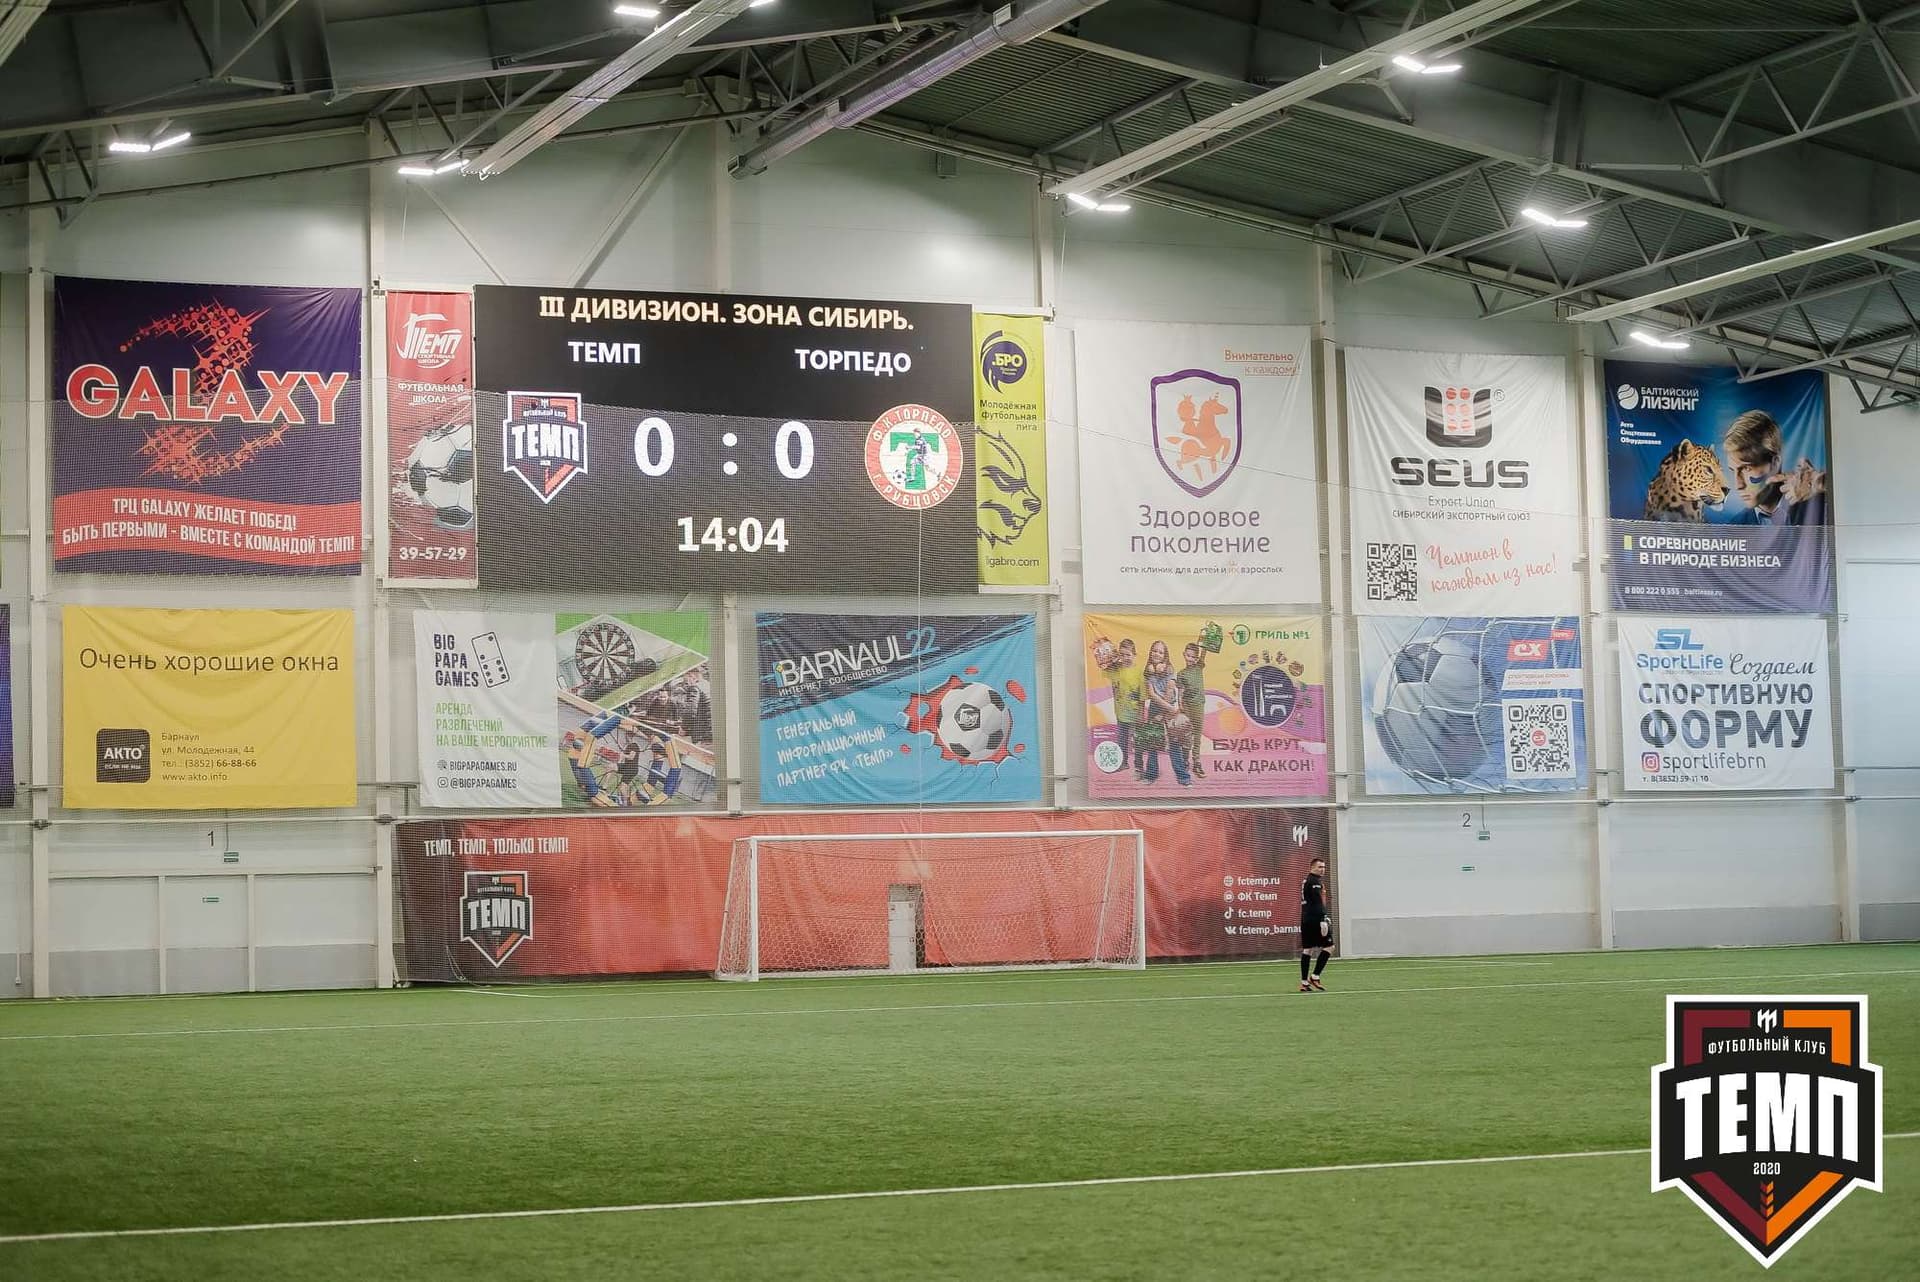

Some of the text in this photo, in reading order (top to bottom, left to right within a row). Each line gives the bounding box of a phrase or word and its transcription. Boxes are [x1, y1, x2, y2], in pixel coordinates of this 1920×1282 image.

[540, 297, 914, 330] III ДИВИЗИОН. ЗОНА СИБИРЬ.
[568, 341, 641, 365] ТЕМП
[1225, 350, 1294, 360] Внимательно
[796, 350, 911, 374] ТОРПЕДО
[66, 363, 349, 424] GALAXY
[398, 383, 465, 393] ФУТБОЛЬНАЯ
[1641, 387, 1699, 397] БАЛТИЙСКИЙ
[412, 395, 447, 403] ШКОЛА
[1641, 396, 1699, 411] ЛИЗИНГ
[981, 411, 1037, 421] футбольная
[1016, 423, 1037, 431] лига
[511, 423, 580, 462] ТЕМП
[634, 417, 675, 477] 0
[774, 421, 814, 480] 0
[1391, 457, 1529, 488] SEUS
[1428, 496, 1495, 508] Export Union
[113, 498, 297, 532] ТРЦ GALAXY ЖЕЛАЕТ ПОБЕД!
[1138, 504, 1260, 530] Здоровое
[1393, 509, 1530, 520] СИБИРСКИЙ ЭКСПОРТНЫЙ СОЮЗ
[62, 523, 98, 545] БЫТЬ
[102, 522, 168, 538] ПЕРВЫМИ
[180, 529, 230, 547] ВМЕСТЕ
[234, 533, 241, 548] С
[245, 533, 316, 555] КОМАНДОЙ
[319, 536, 355, 552] ТЕМП!
[678, 517, 788, 553] 14:04
[1131, 535, 1270, 553] поколение
[1639, 536, 1747, 551] СОРЕВНОВАНИЕ
[399, 547, 467, 561] 39-57-29
[1426, 538, 1513, 569] Чемпион в
[1640, 552, 1781, 568] В ПРИРОДЕ БИЗНЕСА
[1141, 566, 1172, 574] клиник
[1175, 566, 1191, 575] для
[1193, 565, 1219, 575] детей
[1241, 566, 1283, 575] взрослых
[1431, 552, 1557, 592] каждом из нас!
[434, 634, 455, 650] BIG
[1255, 630, 1290, 640] ГРИЛЬ
[1655, 629, 1704, 650] SL
[80, 648, 339, 675] Очень хорошие окна
[435, 652, 468, 669] PAPA
[1637, 653, 1723, 671] SportLife
[1729, 653, 1816, 682] Создаем
[436, 670, 479, 688] GAMES
[1638, 683, 1813, 704] СПОРТИВНУЮ
[436, 703, 473, 715] АРЕНДА
[436, 718, 503, 732] РАЗВЛЕЧЕНИЙ
[777, 710, 857, 741] ГЕНЕРАЛЬНЫЙ
[1640, 709, 1813, 749] ФОРМУ
[162, 732, 199, 742] Барнаул
[437, 735, 547, 747] НА ВАШЕ МЕРОПРИЯТИЕ
[104, 747, 142, 760] АКТО
[162, 747, 173, 755] ул.
[777, 726, 886, 765] ИНФОРМАЦИОННЫЙ
[1213, 738, 1305, 754] БУДЬ КРУТ,
[185, 759, 214, 768] (3852)
[216, 759, 256, 767] 66-88-66
[450, 761, 517, 772] BIGPAPAGAMES.RU
[777, 749, 893, 788] ПАРТНЕР ФК «ТЕМП»
[1214, 759, 1315, 774] КАК ДРАКОН!
[1663, 752, 1766, 773] sportlifebrn
[162, 773, 227, 781] www.akto.info
[450, 777, 516, 789] @BIGPAPAGAMES
[1462, 812, 1472, 828] 2
[207, 830, 214, 846] 1
[424, 837, 569, 857] ТЕМП, ТЕМП, ТОЛЬКО ТЕМП!
[1238, 877, 1280, 887] fctemp.ru
[1238, 892, 1278, 901] ФК Темп
[467, 898, 526, 931] ТЕМП
[1238, 909, 1272, 919] fc.temp
